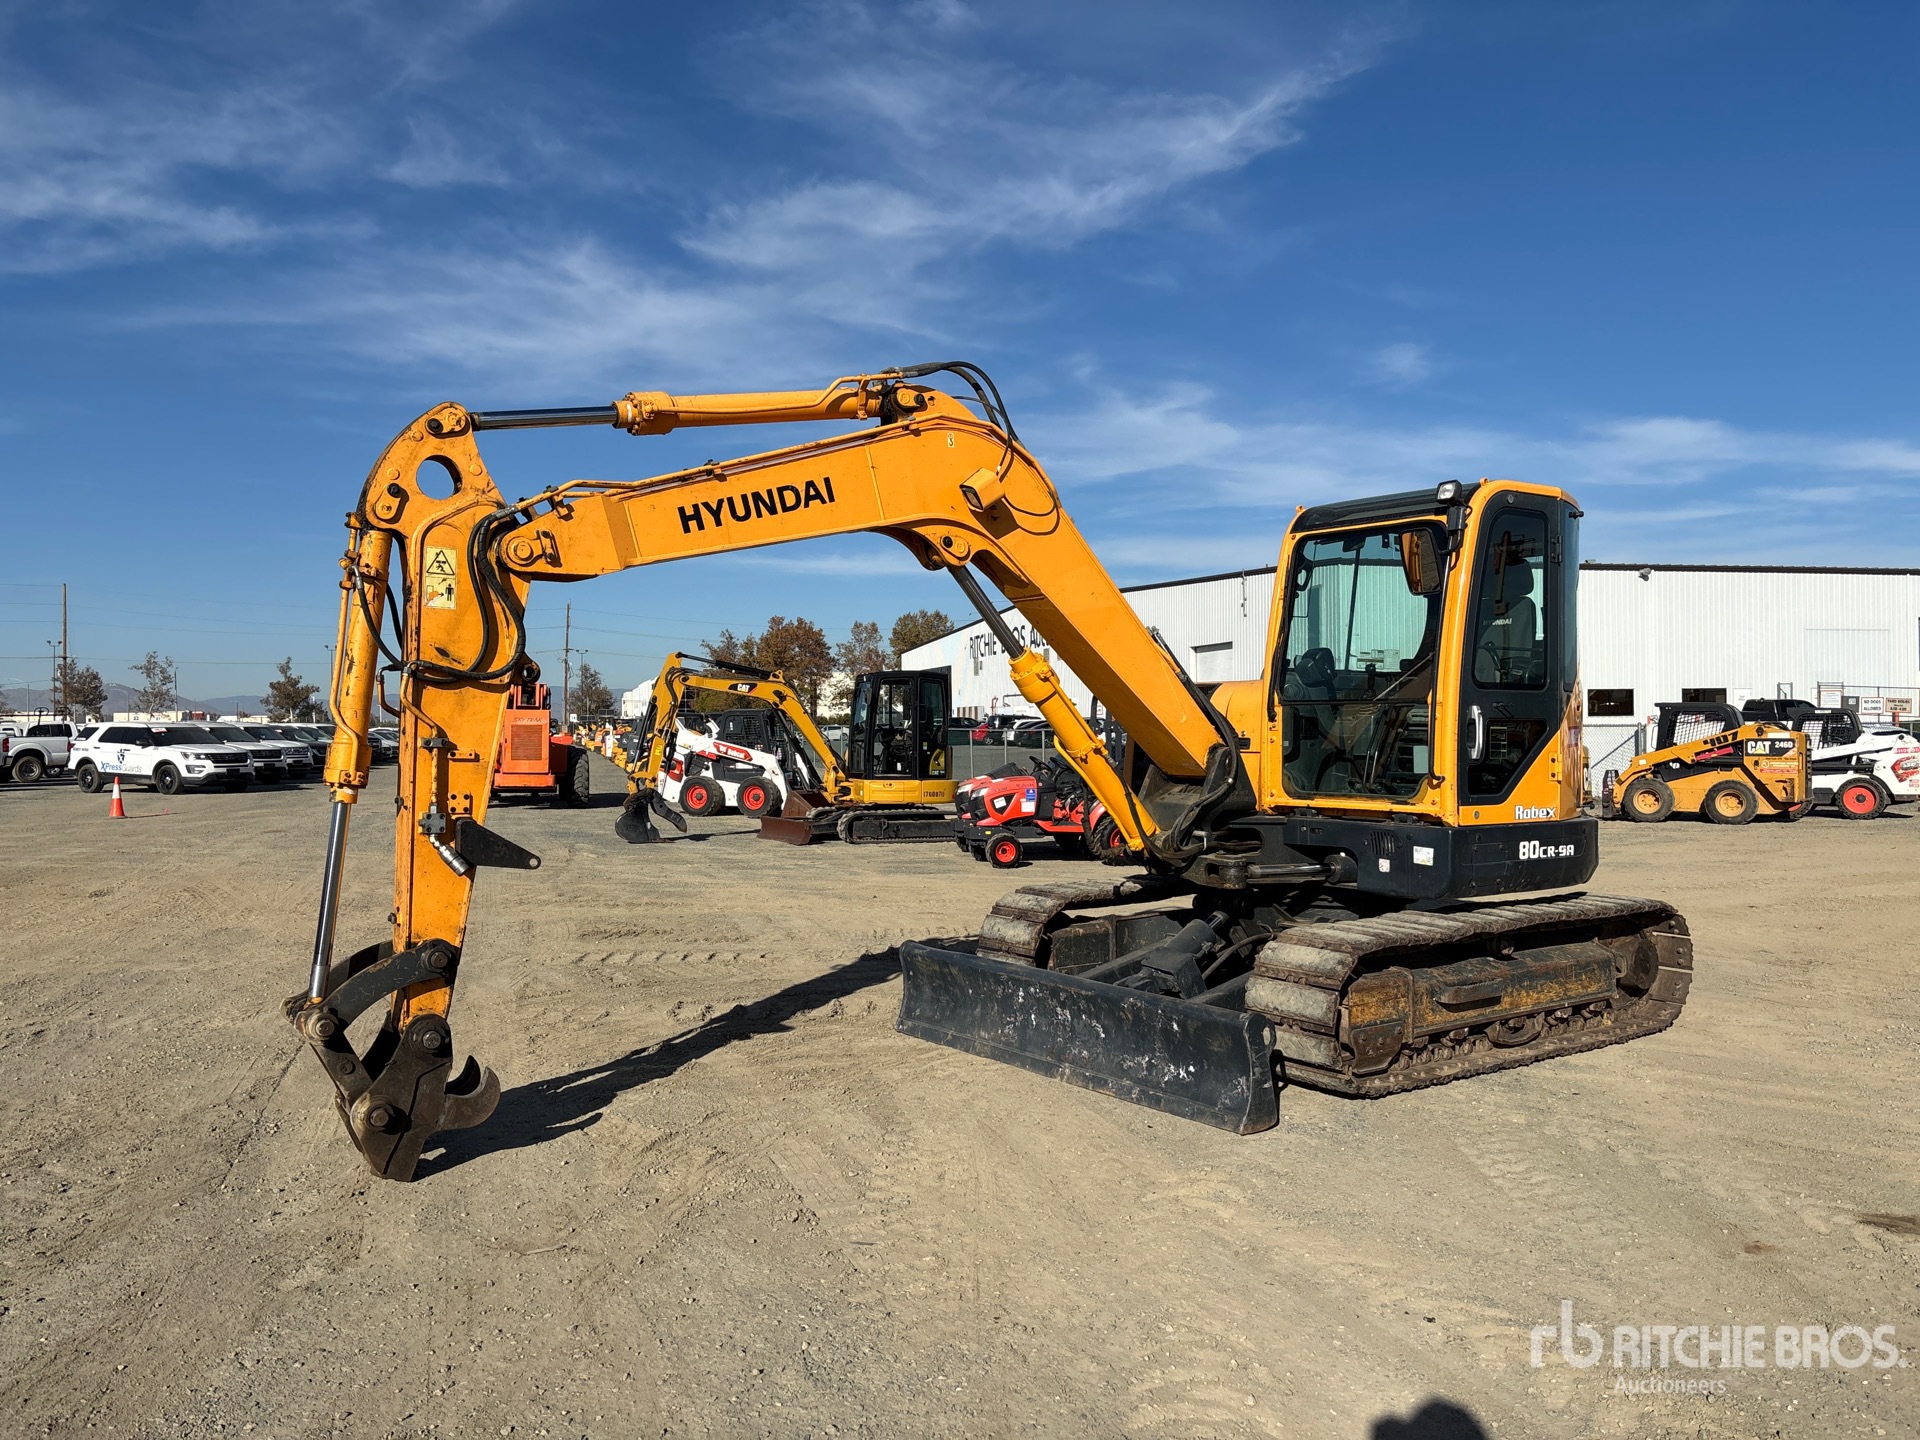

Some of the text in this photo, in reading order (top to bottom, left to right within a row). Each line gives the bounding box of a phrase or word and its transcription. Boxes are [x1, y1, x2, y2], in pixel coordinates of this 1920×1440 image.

[677, 477, 835, 534] HYUNDAI
[969, 632, 997, 659] RITCHIE
[737, 684, 750, 692] CAT
[727, 748, 746, 760] Bobcat
[1747, 741, 1793, 754] CAT 246D
[1515, 805, 1556, 820] Robex
